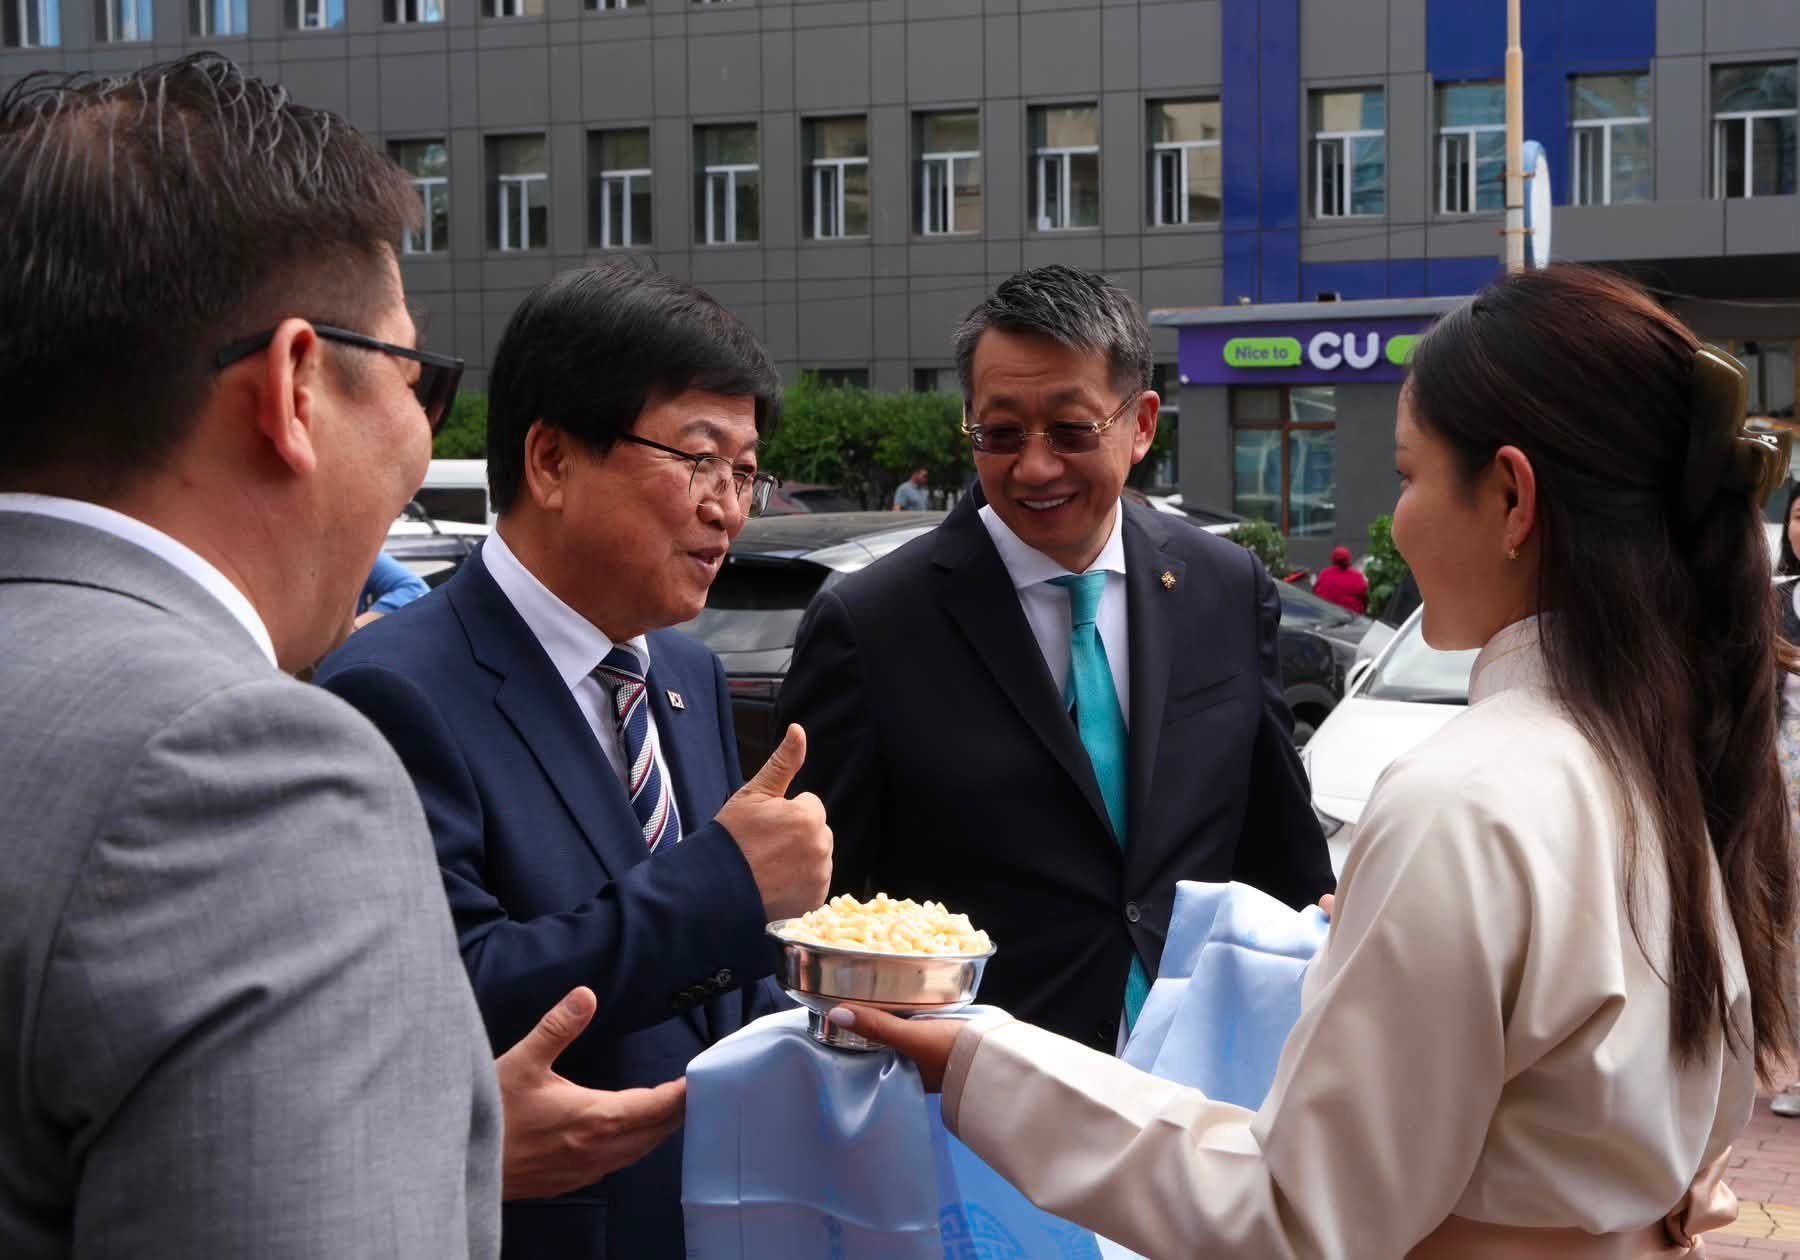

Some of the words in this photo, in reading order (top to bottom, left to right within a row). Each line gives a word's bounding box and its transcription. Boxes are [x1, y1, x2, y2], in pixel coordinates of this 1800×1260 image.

[1235, 346, 1269, 360] Nice
[1273, 346, 1289, 360] to
[1308, 331, 1380, 370] CU
